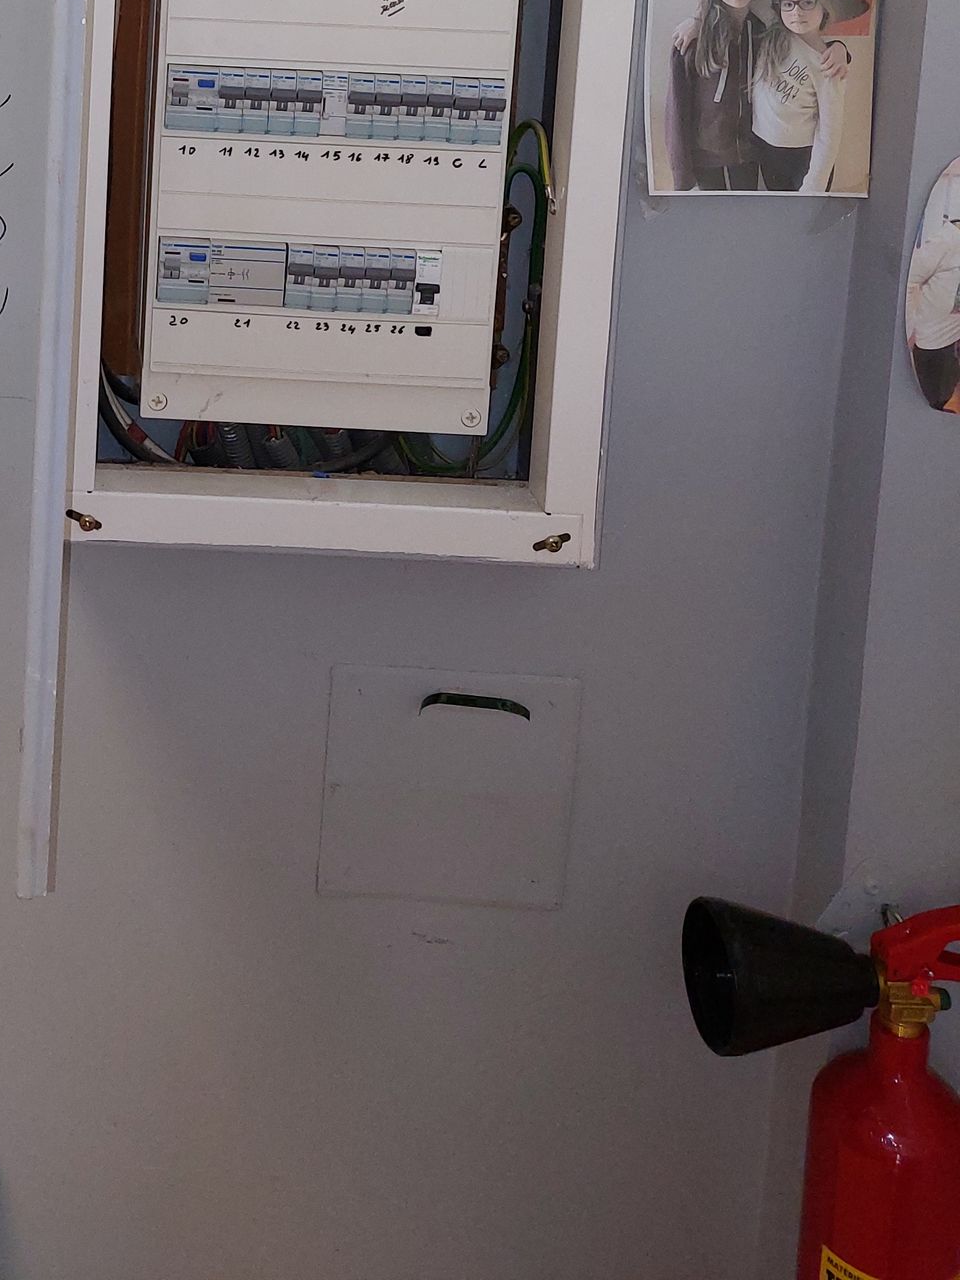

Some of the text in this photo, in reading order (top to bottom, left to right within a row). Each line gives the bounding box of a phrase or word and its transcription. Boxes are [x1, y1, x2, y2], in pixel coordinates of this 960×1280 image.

[781, 58, 810, 86] Jolie
[178, 144, 197, 155] 10
[218, 146, 233, 157] 11
[244, 147, 260, 158] 12
[268, 149, 285, 159] 13
[294, 150, 310, 162] 14
[320, 150, 342, 161] 15
[348, 152, 362, 162] 16
[373, 152, 390, 162] 17
[397, 153, 415, 164] 18
[452, 158, 463, 168] C
[478, 158, 488, 169] L
[169, 315, 406, 335] 20 21 22 23 24 25 26
